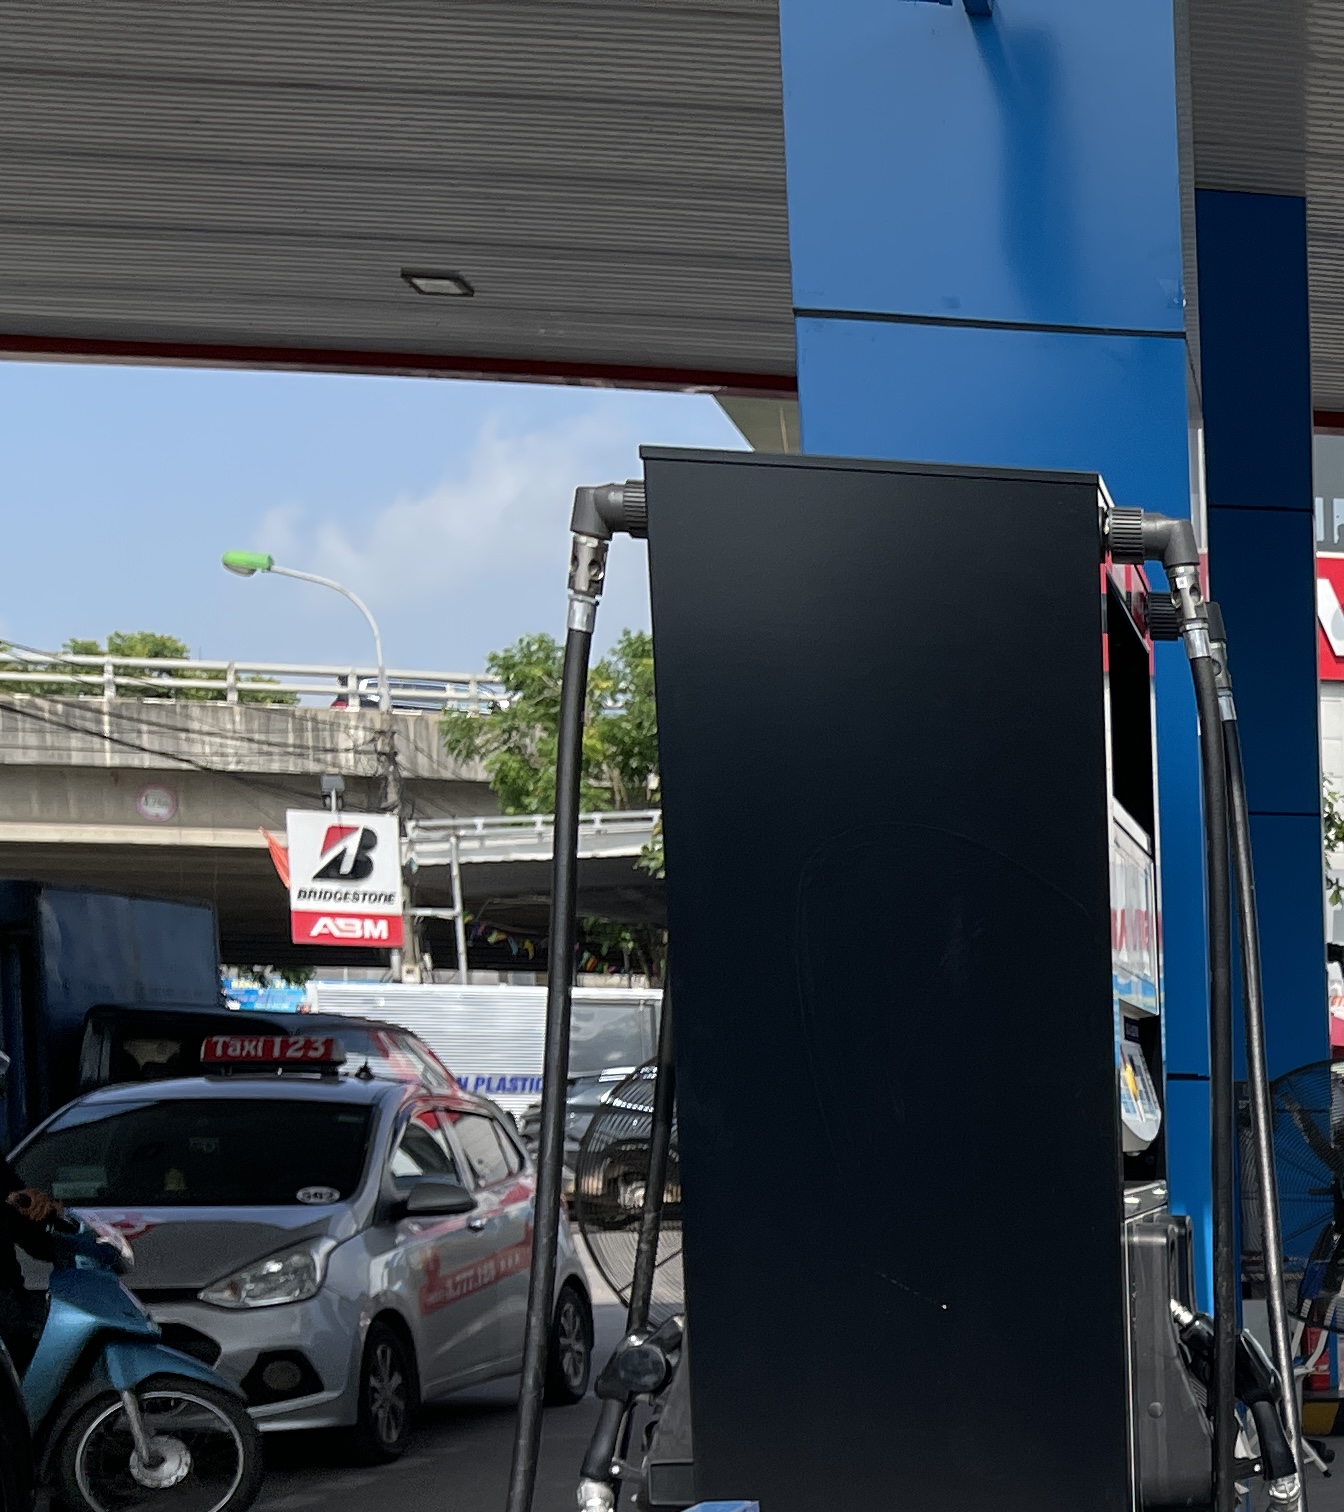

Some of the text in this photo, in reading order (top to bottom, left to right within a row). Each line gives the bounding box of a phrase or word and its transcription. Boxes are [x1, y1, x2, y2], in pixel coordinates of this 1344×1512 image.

[297, 887, 396, 905] BRIDGESTONE
[310, 916, 389, 940] ABM
[212, 1036, 326, 1059] Taxi 123
